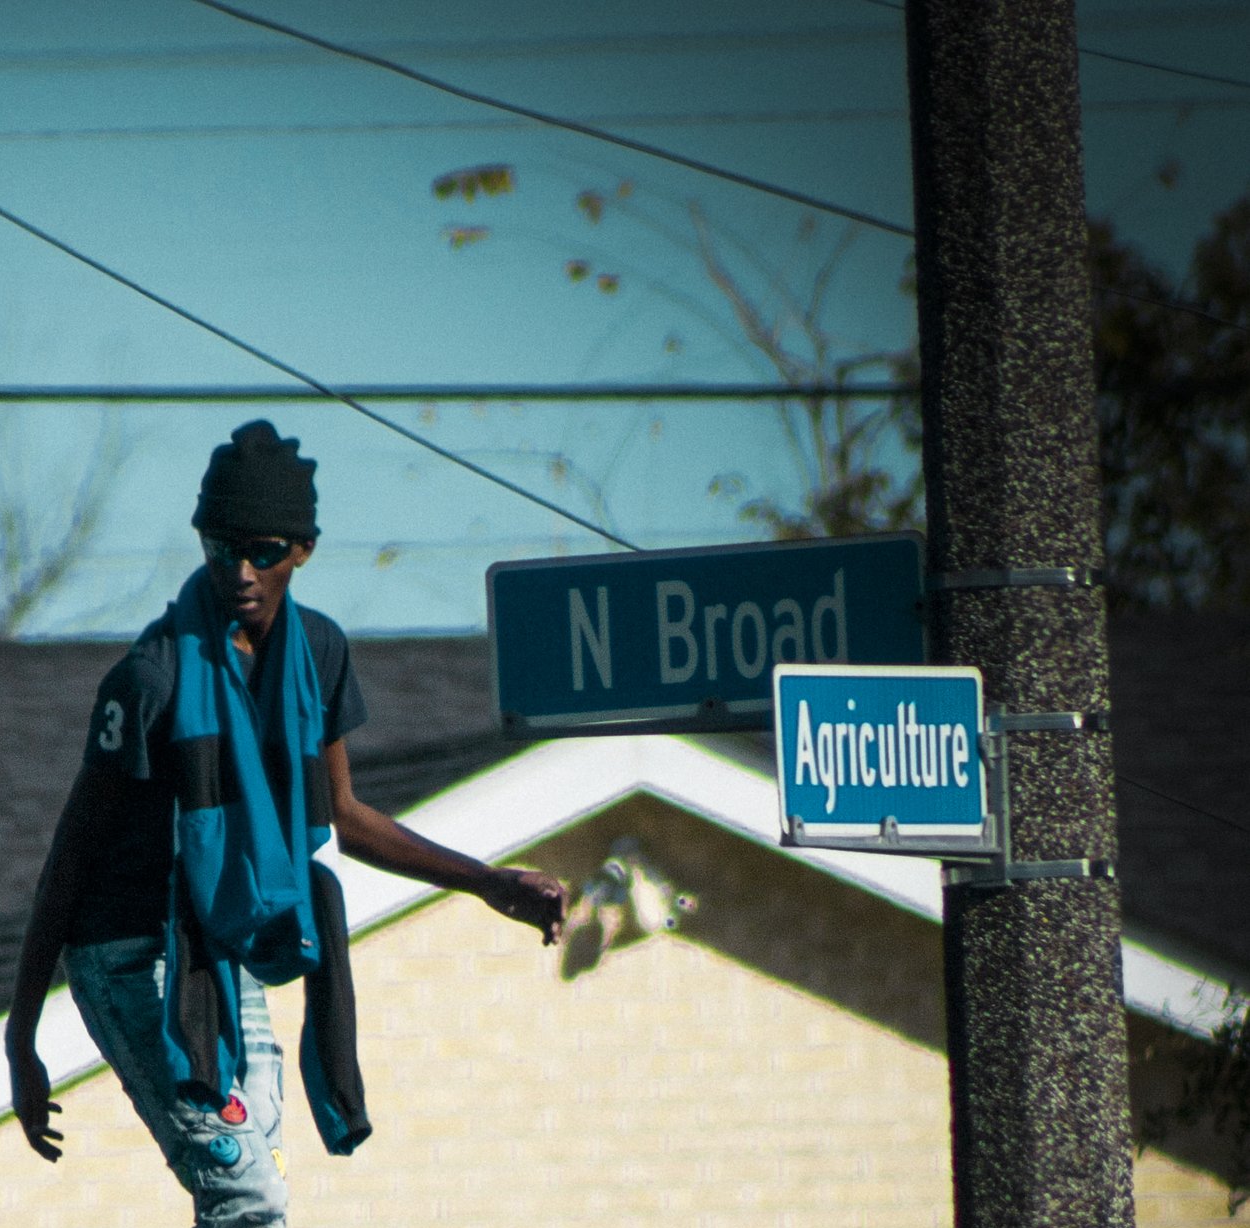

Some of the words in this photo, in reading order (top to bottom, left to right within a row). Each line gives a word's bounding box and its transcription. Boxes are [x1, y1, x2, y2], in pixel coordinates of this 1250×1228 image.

[568, 585, 613, 692] N
[656, 568, 850, 686] Broad
[99, 699, 125, 751] 3
[794, 699, 970, 814] Agriculture
